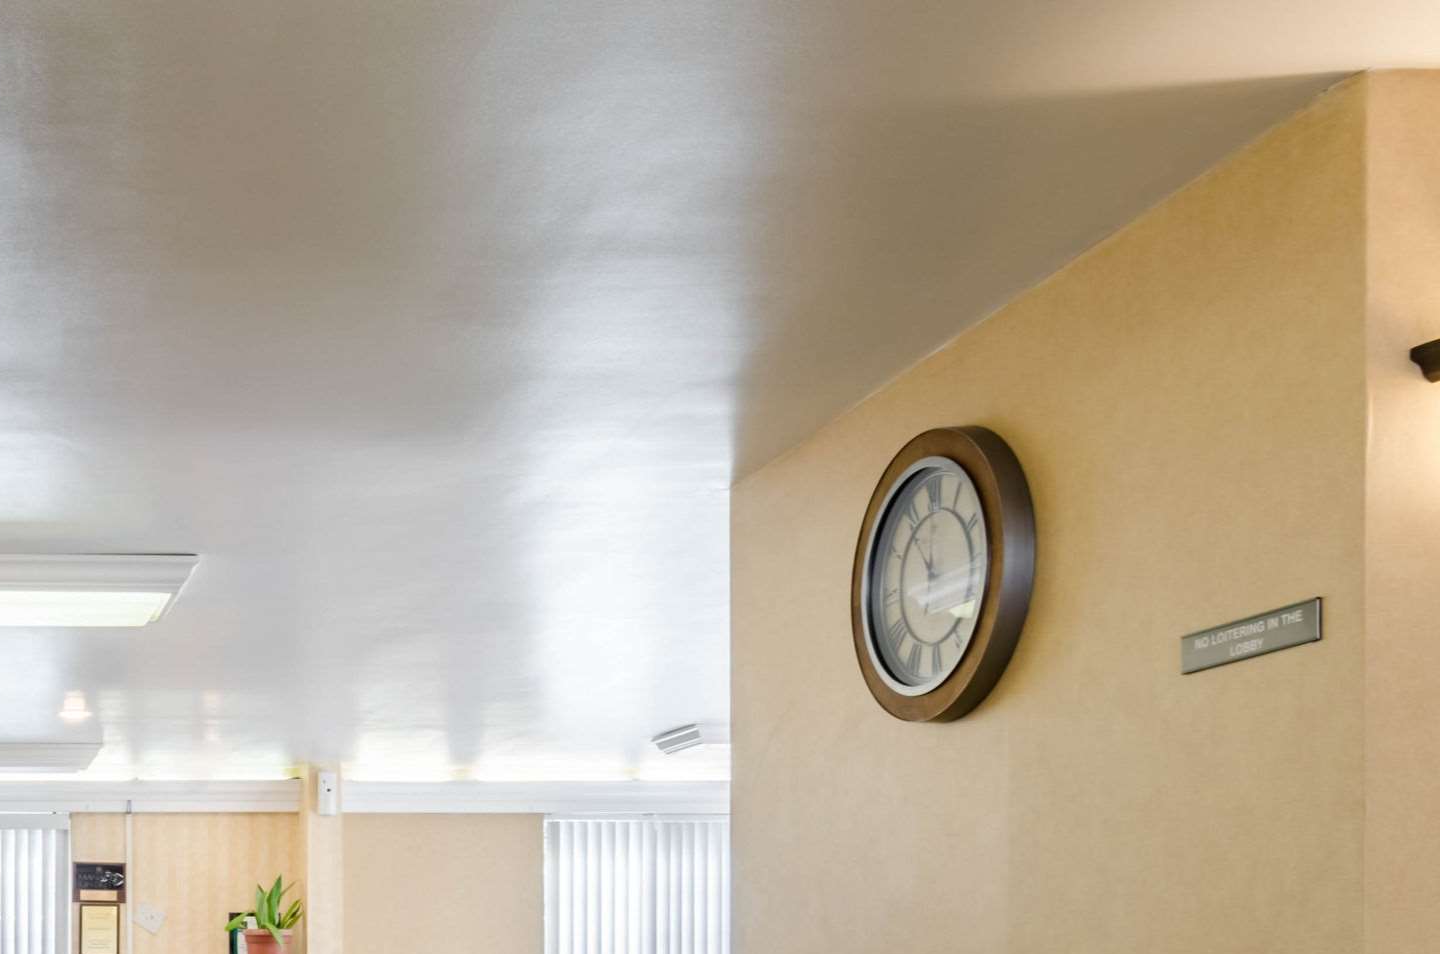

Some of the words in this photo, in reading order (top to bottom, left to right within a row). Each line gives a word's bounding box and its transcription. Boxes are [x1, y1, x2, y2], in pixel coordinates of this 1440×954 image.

[1193, 637, 1210, 650] NO
[1211, 621, 1265, 646] LOITERING
[1267, 619, 1279, 630] IN
[1280, 609, 1304, 625] THE
[1229, 638, 1264, 657] LOBBY
